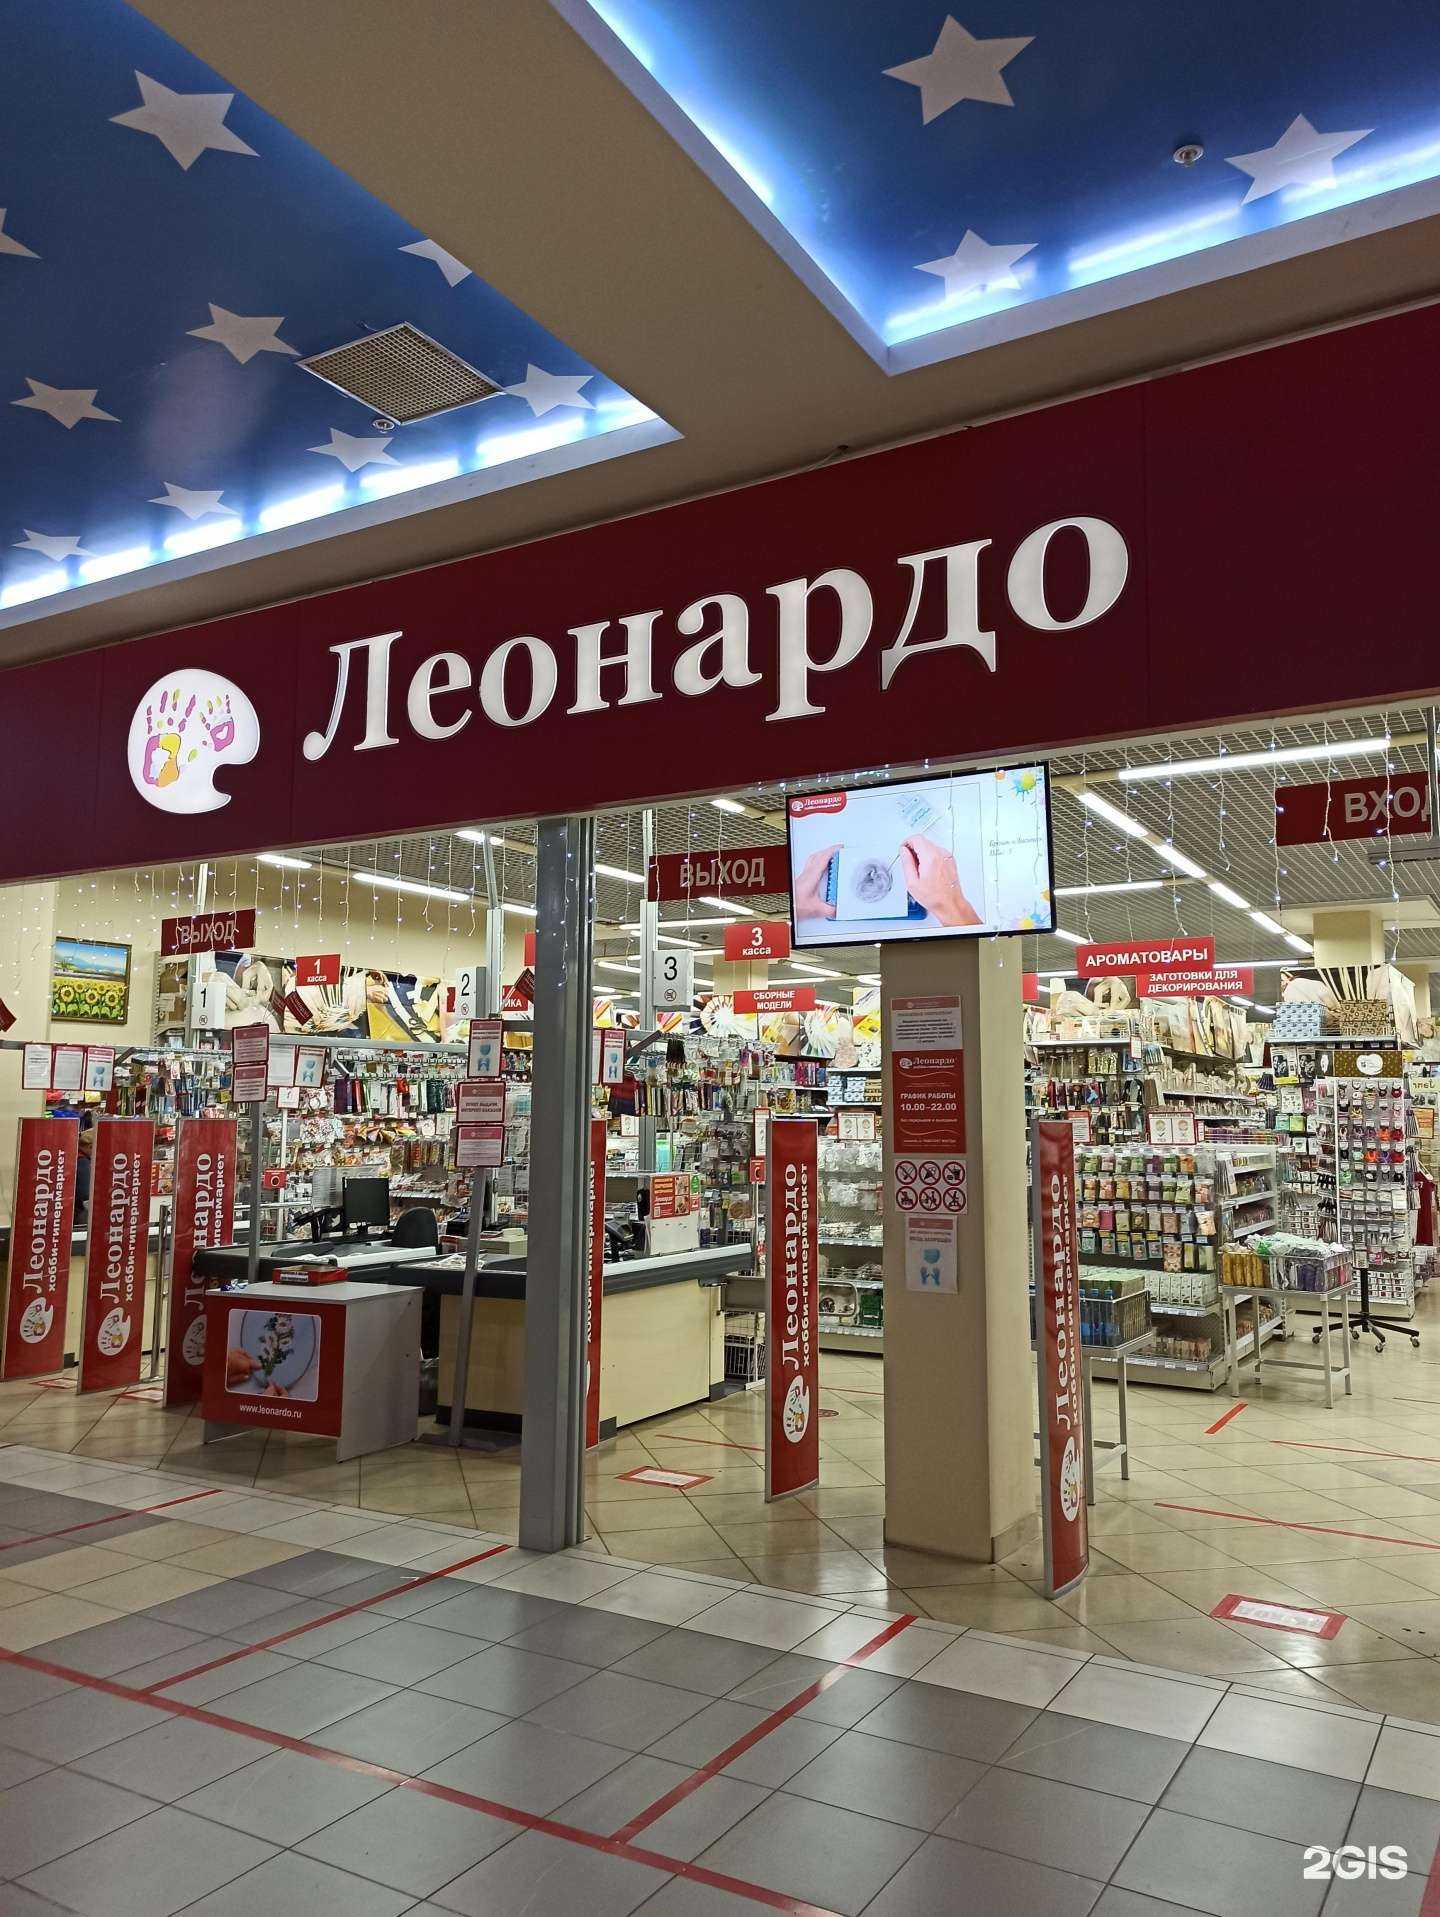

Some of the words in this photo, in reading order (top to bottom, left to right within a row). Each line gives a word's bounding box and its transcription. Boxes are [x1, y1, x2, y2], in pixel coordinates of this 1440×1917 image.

[303, 516, 1129, 762] Леонардо
[679, 857, 766, 888] ВЫХОД
[180, 918, 235, 945] ВЫХОД
[751, 927, 763, 946] 3
[742, 946, 772, 956] касса
[1085, 947, 1209, 968] АРОМАТОВАРЫ
[313, 959, 321, 975] 1
[664, 956, 678, 981] 3
[1149, 971, 1214, 982] ЗАГОТОВКИ
[1214, 970, 1238, 981] ДЛЯ
[307, 975, 328, 984] касса
[461, 973, 470, 996] 2
[1147, 981, 1243, 993] ДЕКОРИРОВАНИЯ
[201, 988, 207, 1007] 1
[753, 990, 796, 1000] СБОРНЫЕ
[756, 1001, 793, 1010] МОДЕЛИ
[913, 1057, 955, 1066] Леонардо
[22, 1149, 54, 1294] Леонардо
[48, 1149, 65, 1292] хобби-гипермаркет
[100, 1152, 130, 1304] Леонардо
[125, 1153, 141, 1302] хобби-гипермаркет
[782, 1163, 802, 1371] Леонардо
[801, 1163, 809, 1366] хобби-гипермаркет
[1050, 1174, 1071, 1430] Леонардо
[1063, 1174, 1078, 1425] хобби-гипермаркет
[239, 1403, 302, 1419] www.leonardo.ru
